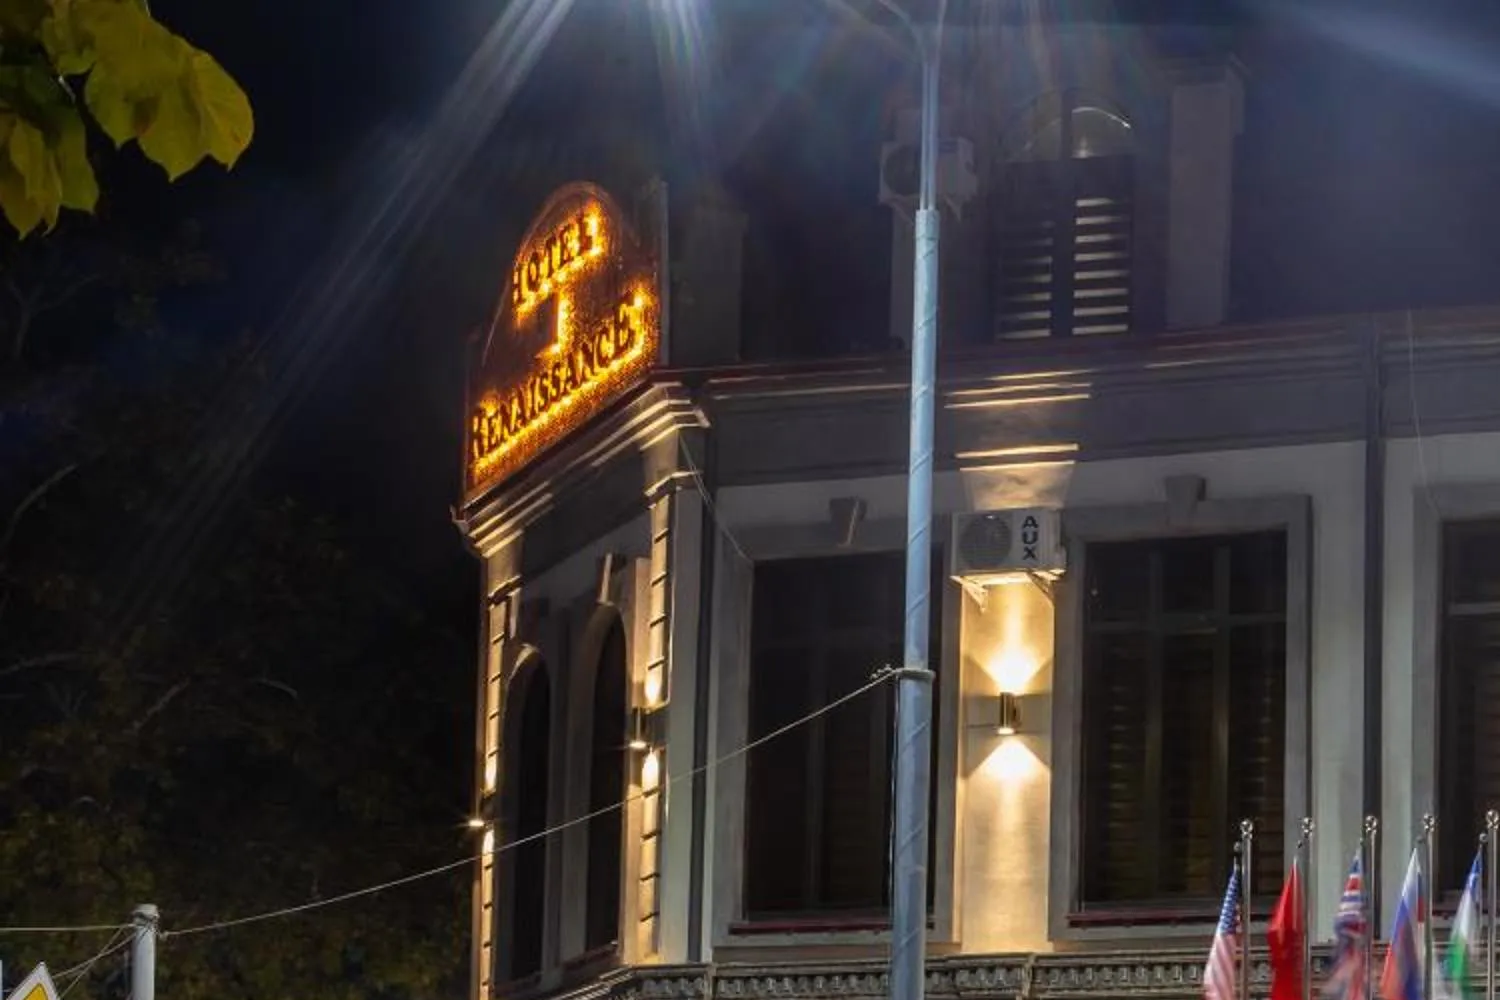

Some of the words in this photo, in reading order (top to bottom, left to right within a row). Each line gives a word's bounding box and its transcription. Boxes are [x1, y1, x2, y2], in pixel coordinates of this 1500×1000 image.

[511, 210, 594, 306] HOTEL
[470, 292, 637, 459] RENAISSANCE
[1022, 516, 1039, 560] AUX
